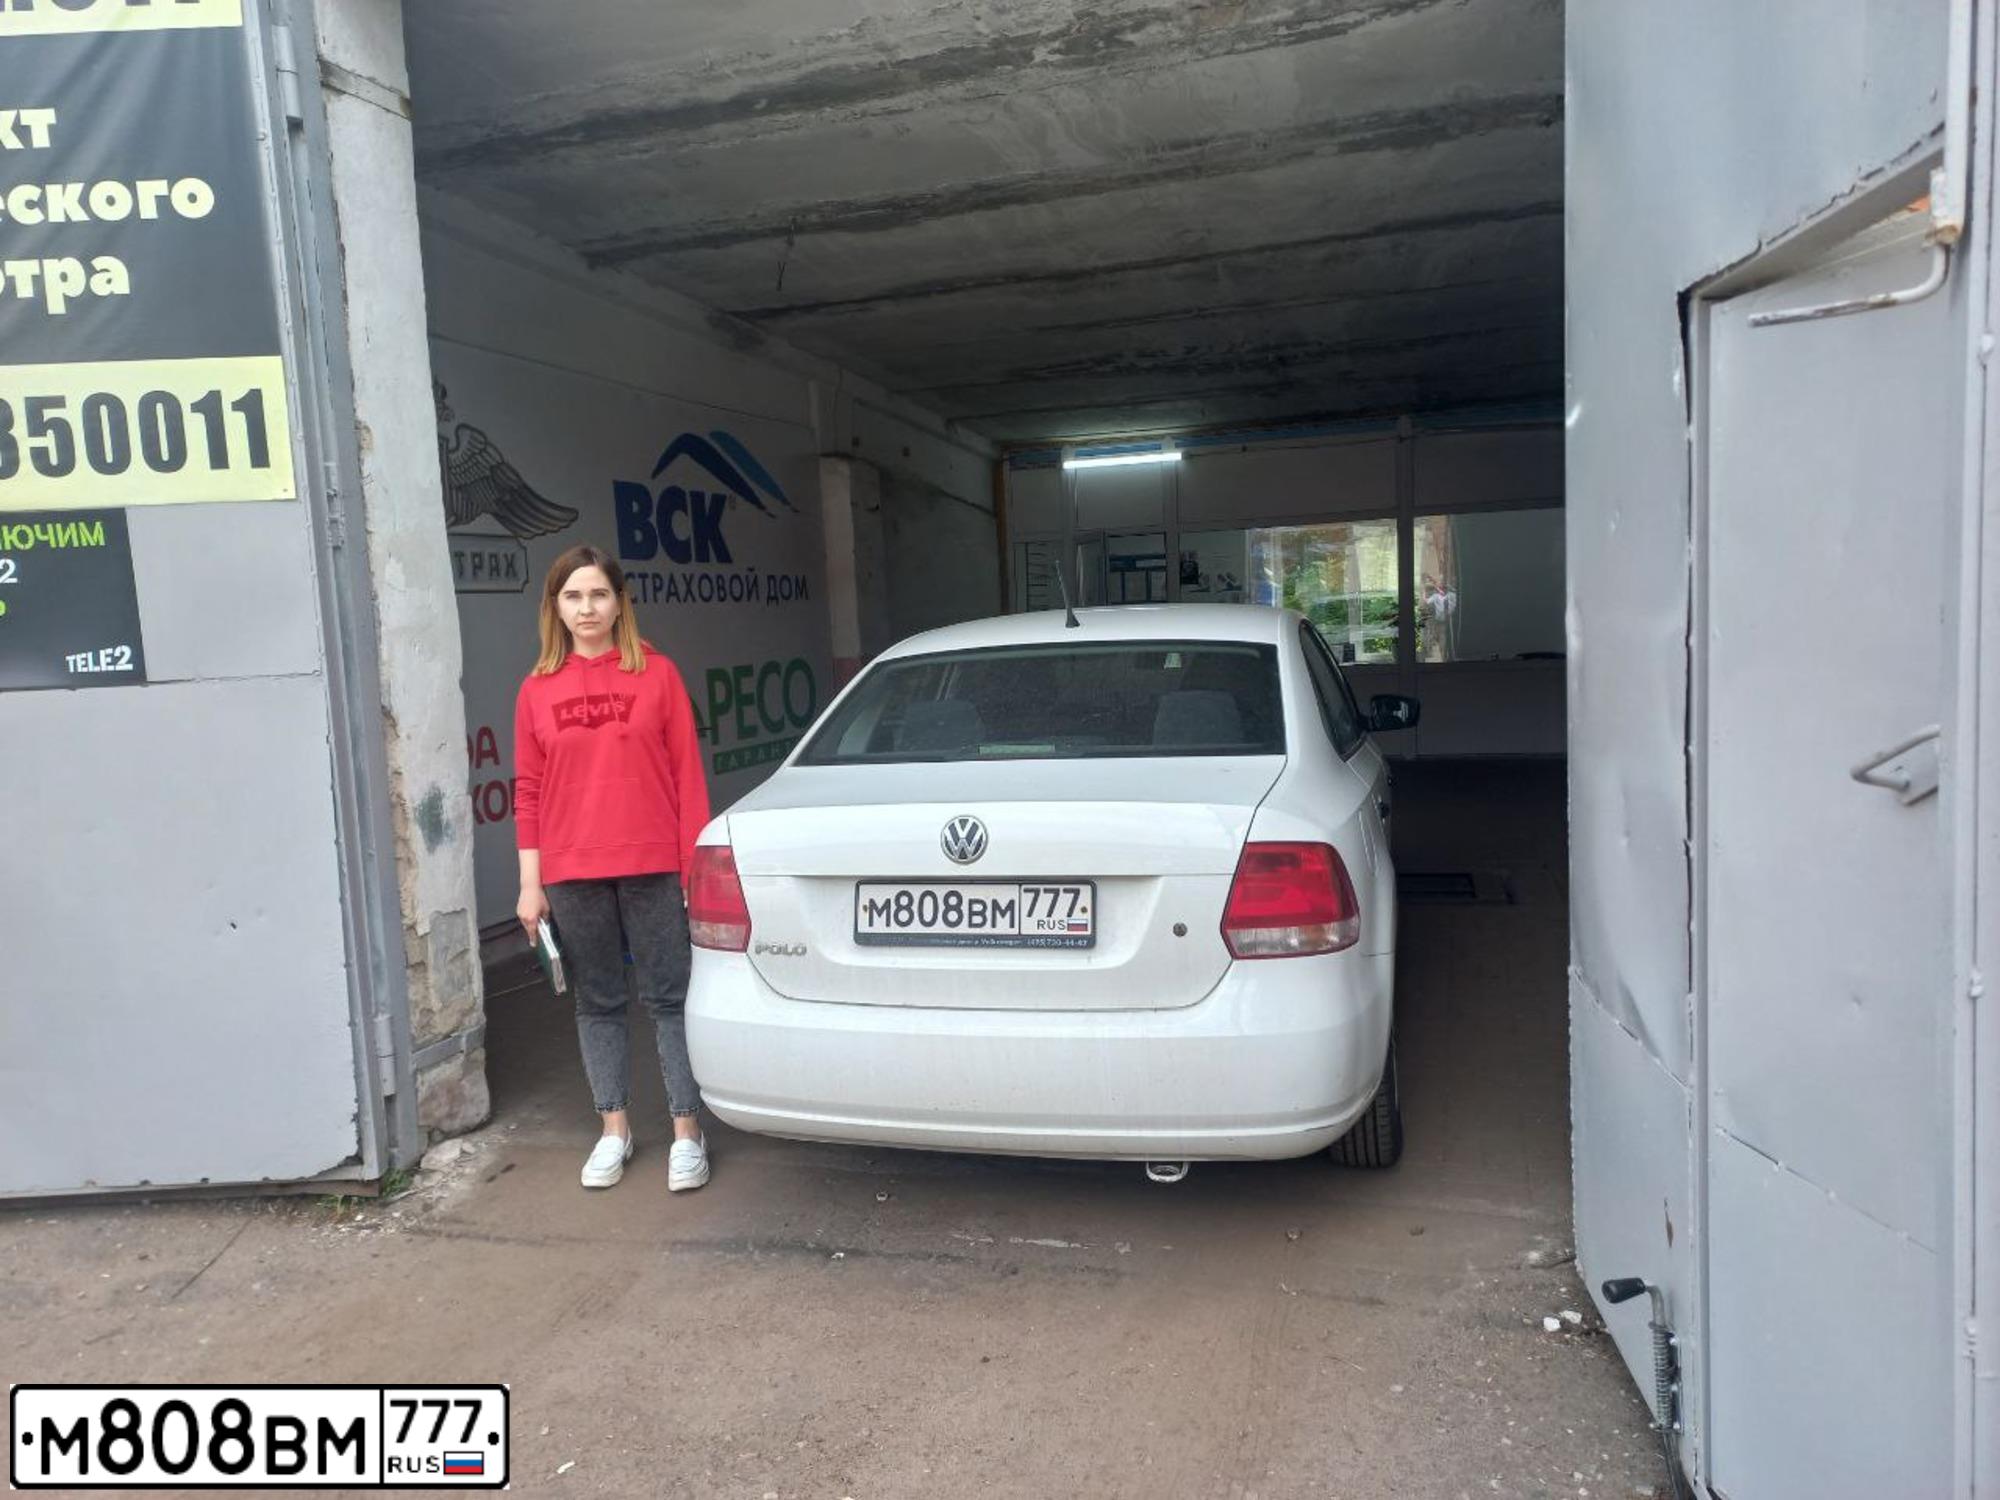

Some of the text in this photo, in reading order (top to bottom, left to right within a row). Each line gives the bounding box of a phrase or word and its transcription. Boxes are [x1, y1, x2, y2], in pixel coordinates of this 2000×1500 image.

[0, 177, 215, 225] ского
[0, 256, 130, 315] тра
[0, 521, 106, 550] ЮЧИМ
[613, 480, 733, 564] ВСК
[766, 573, 810, 606] ДОМ
[66, 645, 134, 673] TELE2
[705, 658, 817, 746] РЕСО
[868, 887, 1081, 928] М808ВМ 777
[1036, 919, 1066, 931] RUS
